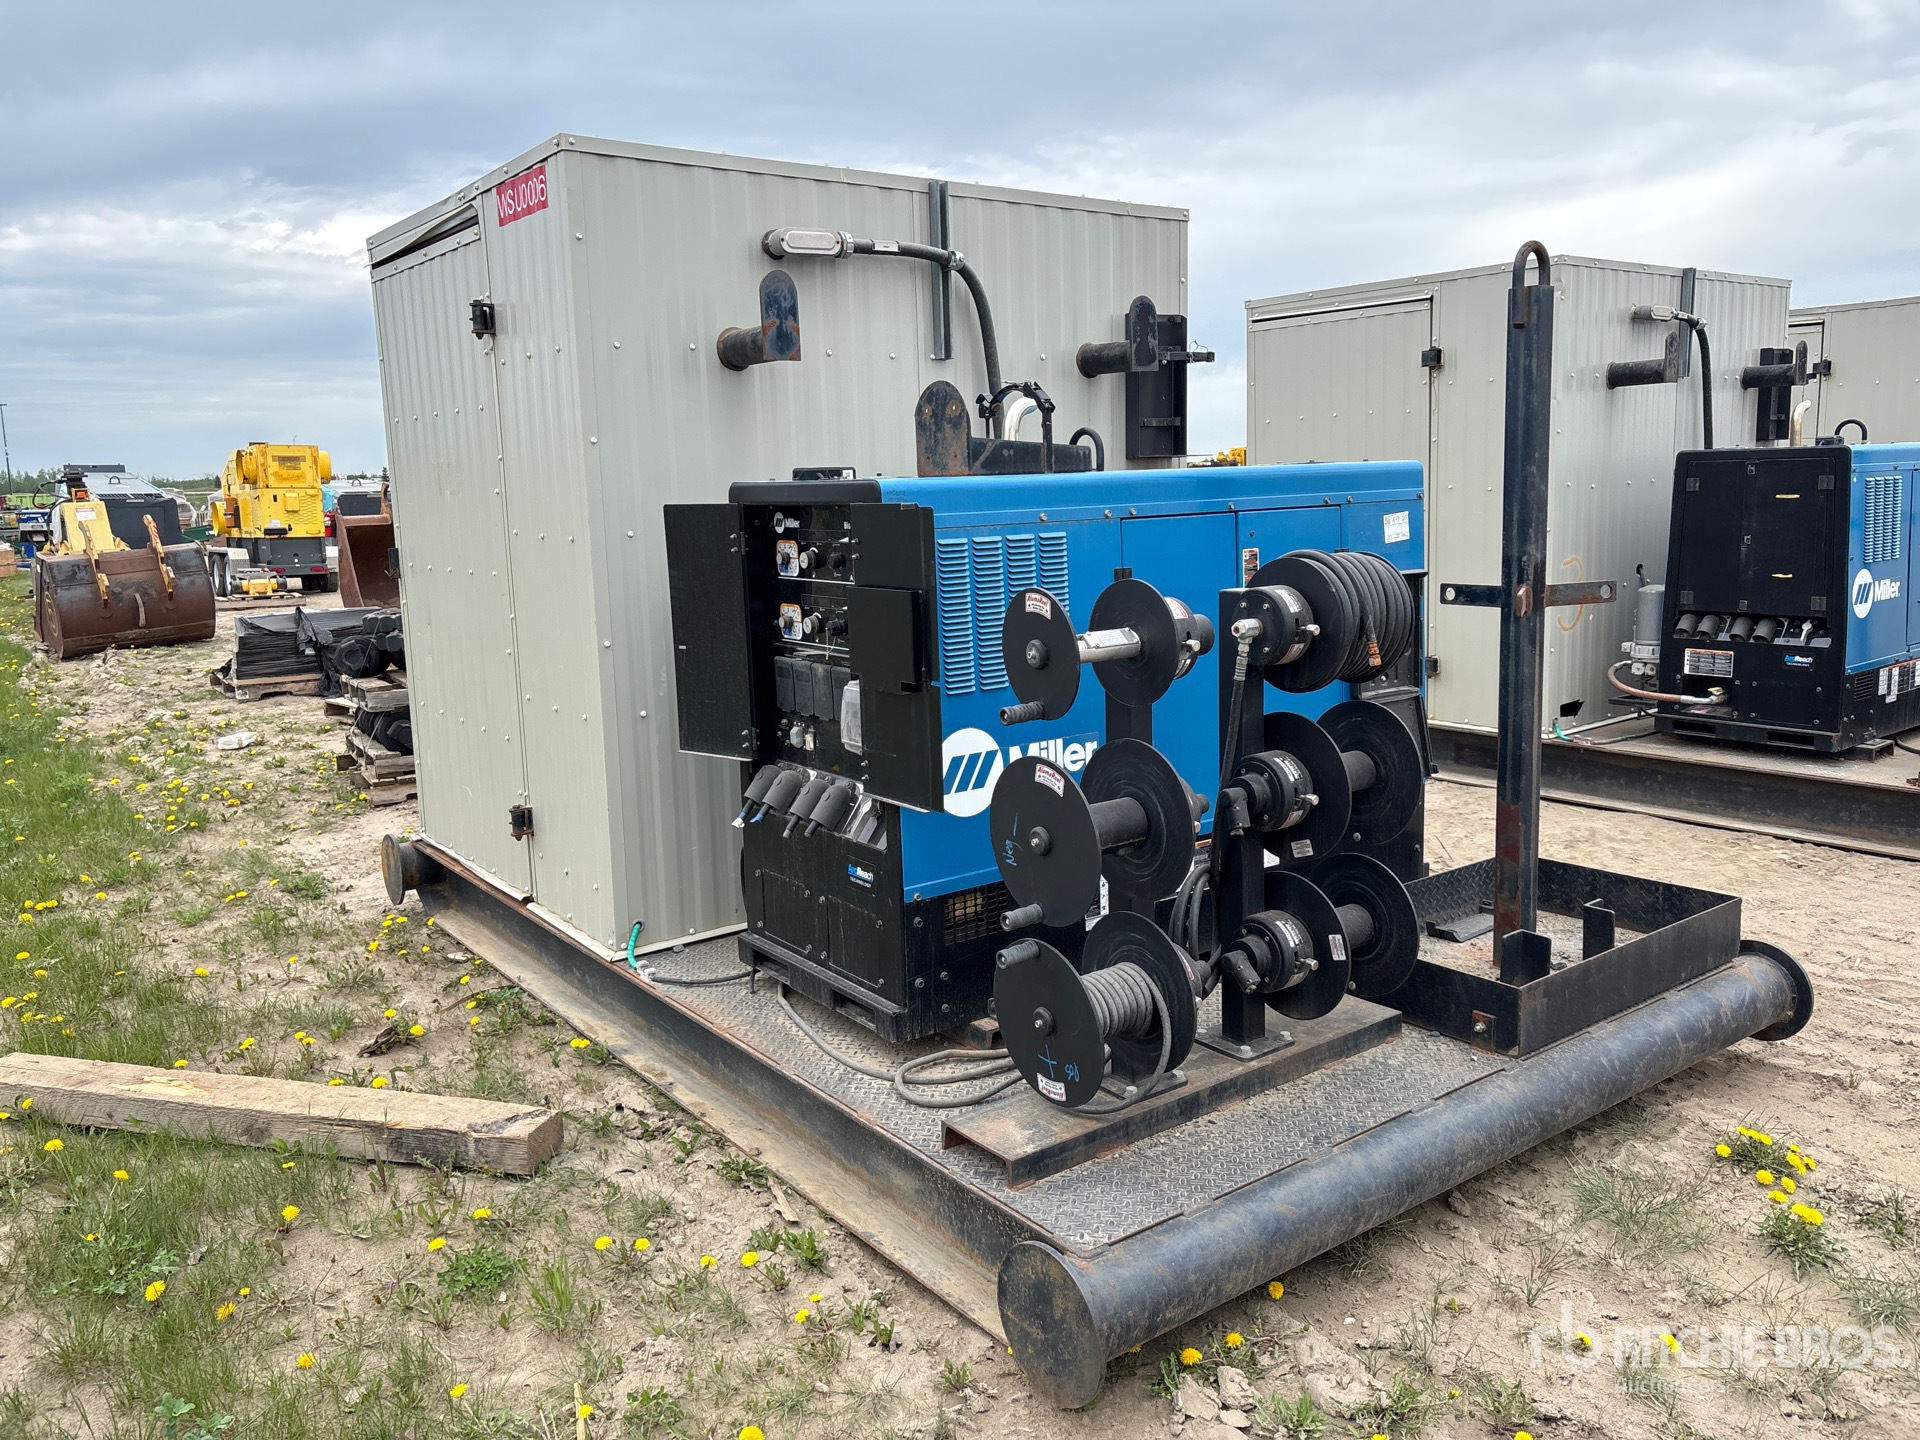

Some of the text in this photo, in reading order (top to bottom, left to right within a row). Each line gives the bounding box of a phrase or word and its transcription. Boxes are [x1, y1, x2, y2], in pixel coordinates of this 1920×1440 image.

[1874, 579, 1901, 602] Miller
[1009, 738, 1098, 772] Miller
[847, 863, 874, 881] ArcReach
